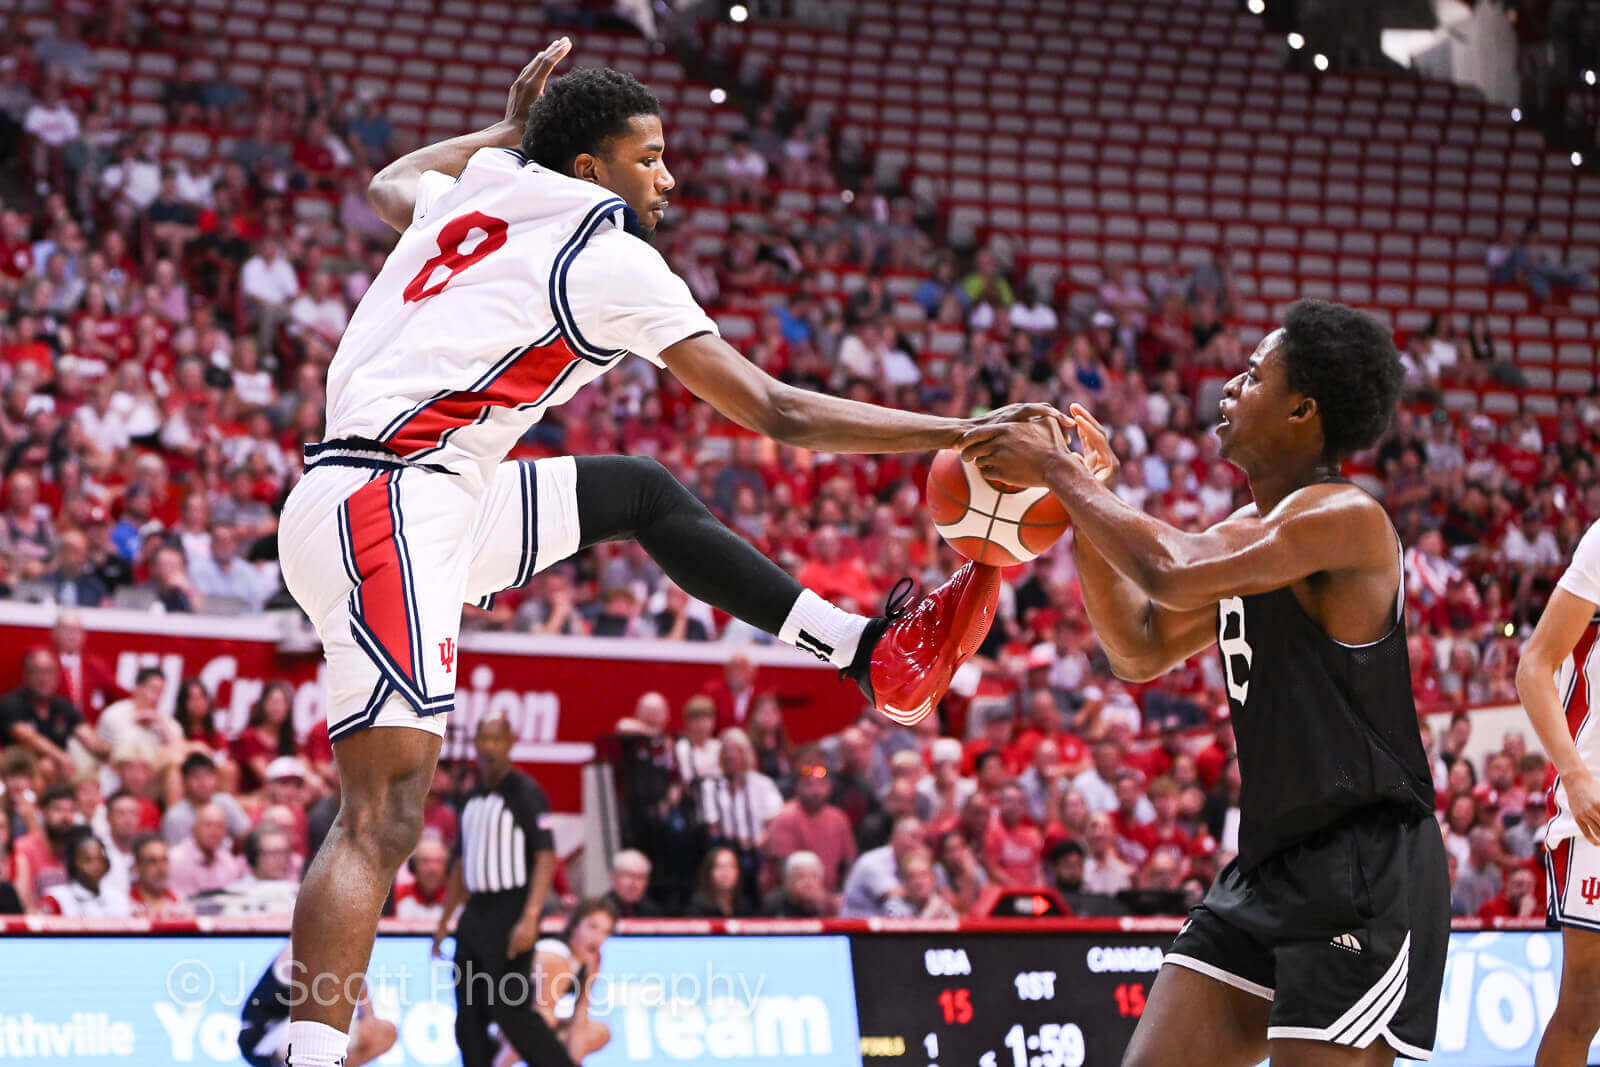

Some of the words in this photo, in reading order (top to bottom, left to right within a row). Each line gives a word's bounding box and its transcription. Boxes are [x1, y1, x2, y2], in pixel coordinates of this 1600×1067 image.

[403, 210, 509, 305] 8
[938, 988, 974, 1024] 15
[1114, 983, 1147, 1018] 15
[1014, 971, 1056, 1000] 1ST
[614, 982, 833, 1061] Team
[1004, 1022, 1085, 1067] 1:59
